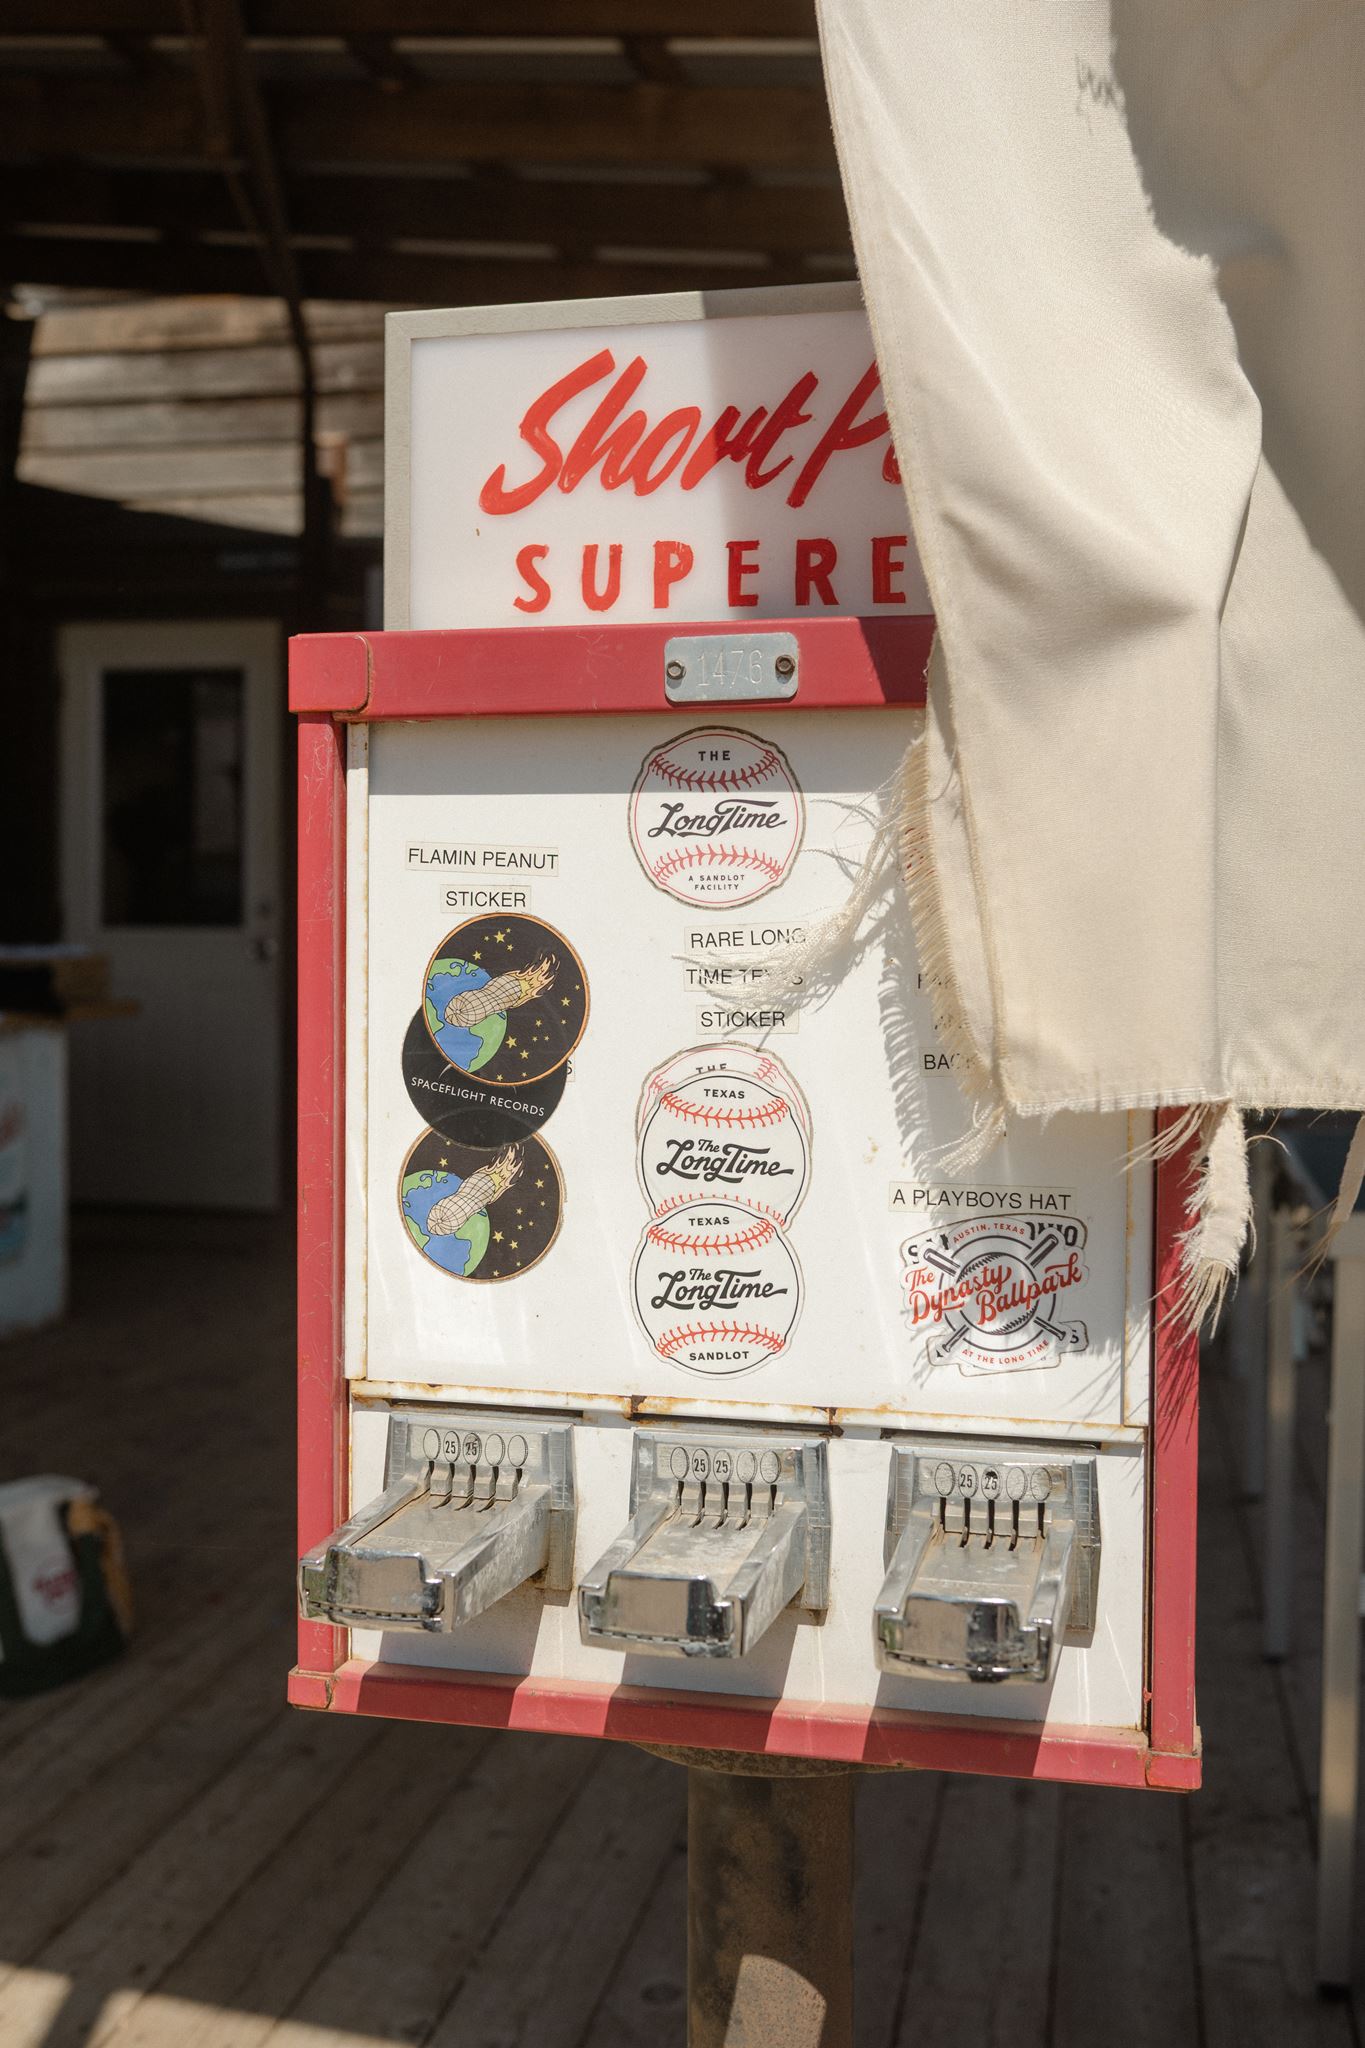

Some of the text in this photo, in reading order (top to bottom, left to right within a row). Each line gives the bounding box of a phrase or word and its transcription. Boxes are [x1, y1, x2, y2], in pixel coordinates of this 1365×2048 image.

[513, 536, 908, 613] SUPERE
[697, 649, 763, 686] 1476
[698, 750, 731, 762] THE
[408, 847, 559, 870] FLAMIN PEANUT
[688, 873, 745, 882] A SANDLOT
[694, 883, 740, 891] FACILITY
[446, 890, 526, 908] STICKER
[690, 927, 807, 949] RARE LONG
[686, 968, 732, 985] TIME
[701, 1011, 786, 1028] STICKER
[411, 1076, 545, 1117] SPACEFLIGHT RECORDS
[703, 1088, 745, 1099] TEXAS
[698, 1138, 720, 1153] The
[893, 1189, 1072, 1210] A PLAYBOYS HAT
[688, 1216, 730, 1226] TEXAS
[994, 1222, 1026, 1236] TEXAS
[689, 1268, 712, 1281] The
[905, 1266, 935, 1291] The
[909, 1264, 1012, 1325] Dynasty
[976, 1252, 1083, 1326] Ballpark
[689, 1351, 750, 1361] SANDLOT
[962, 1339, 1050, 1365] AT THE LONG TIME
[445, 1440, 478, 1456] 25 25
[694, 1458, 729, 1474] 25 25
[960, 1473, 998, 1490] 25 25
